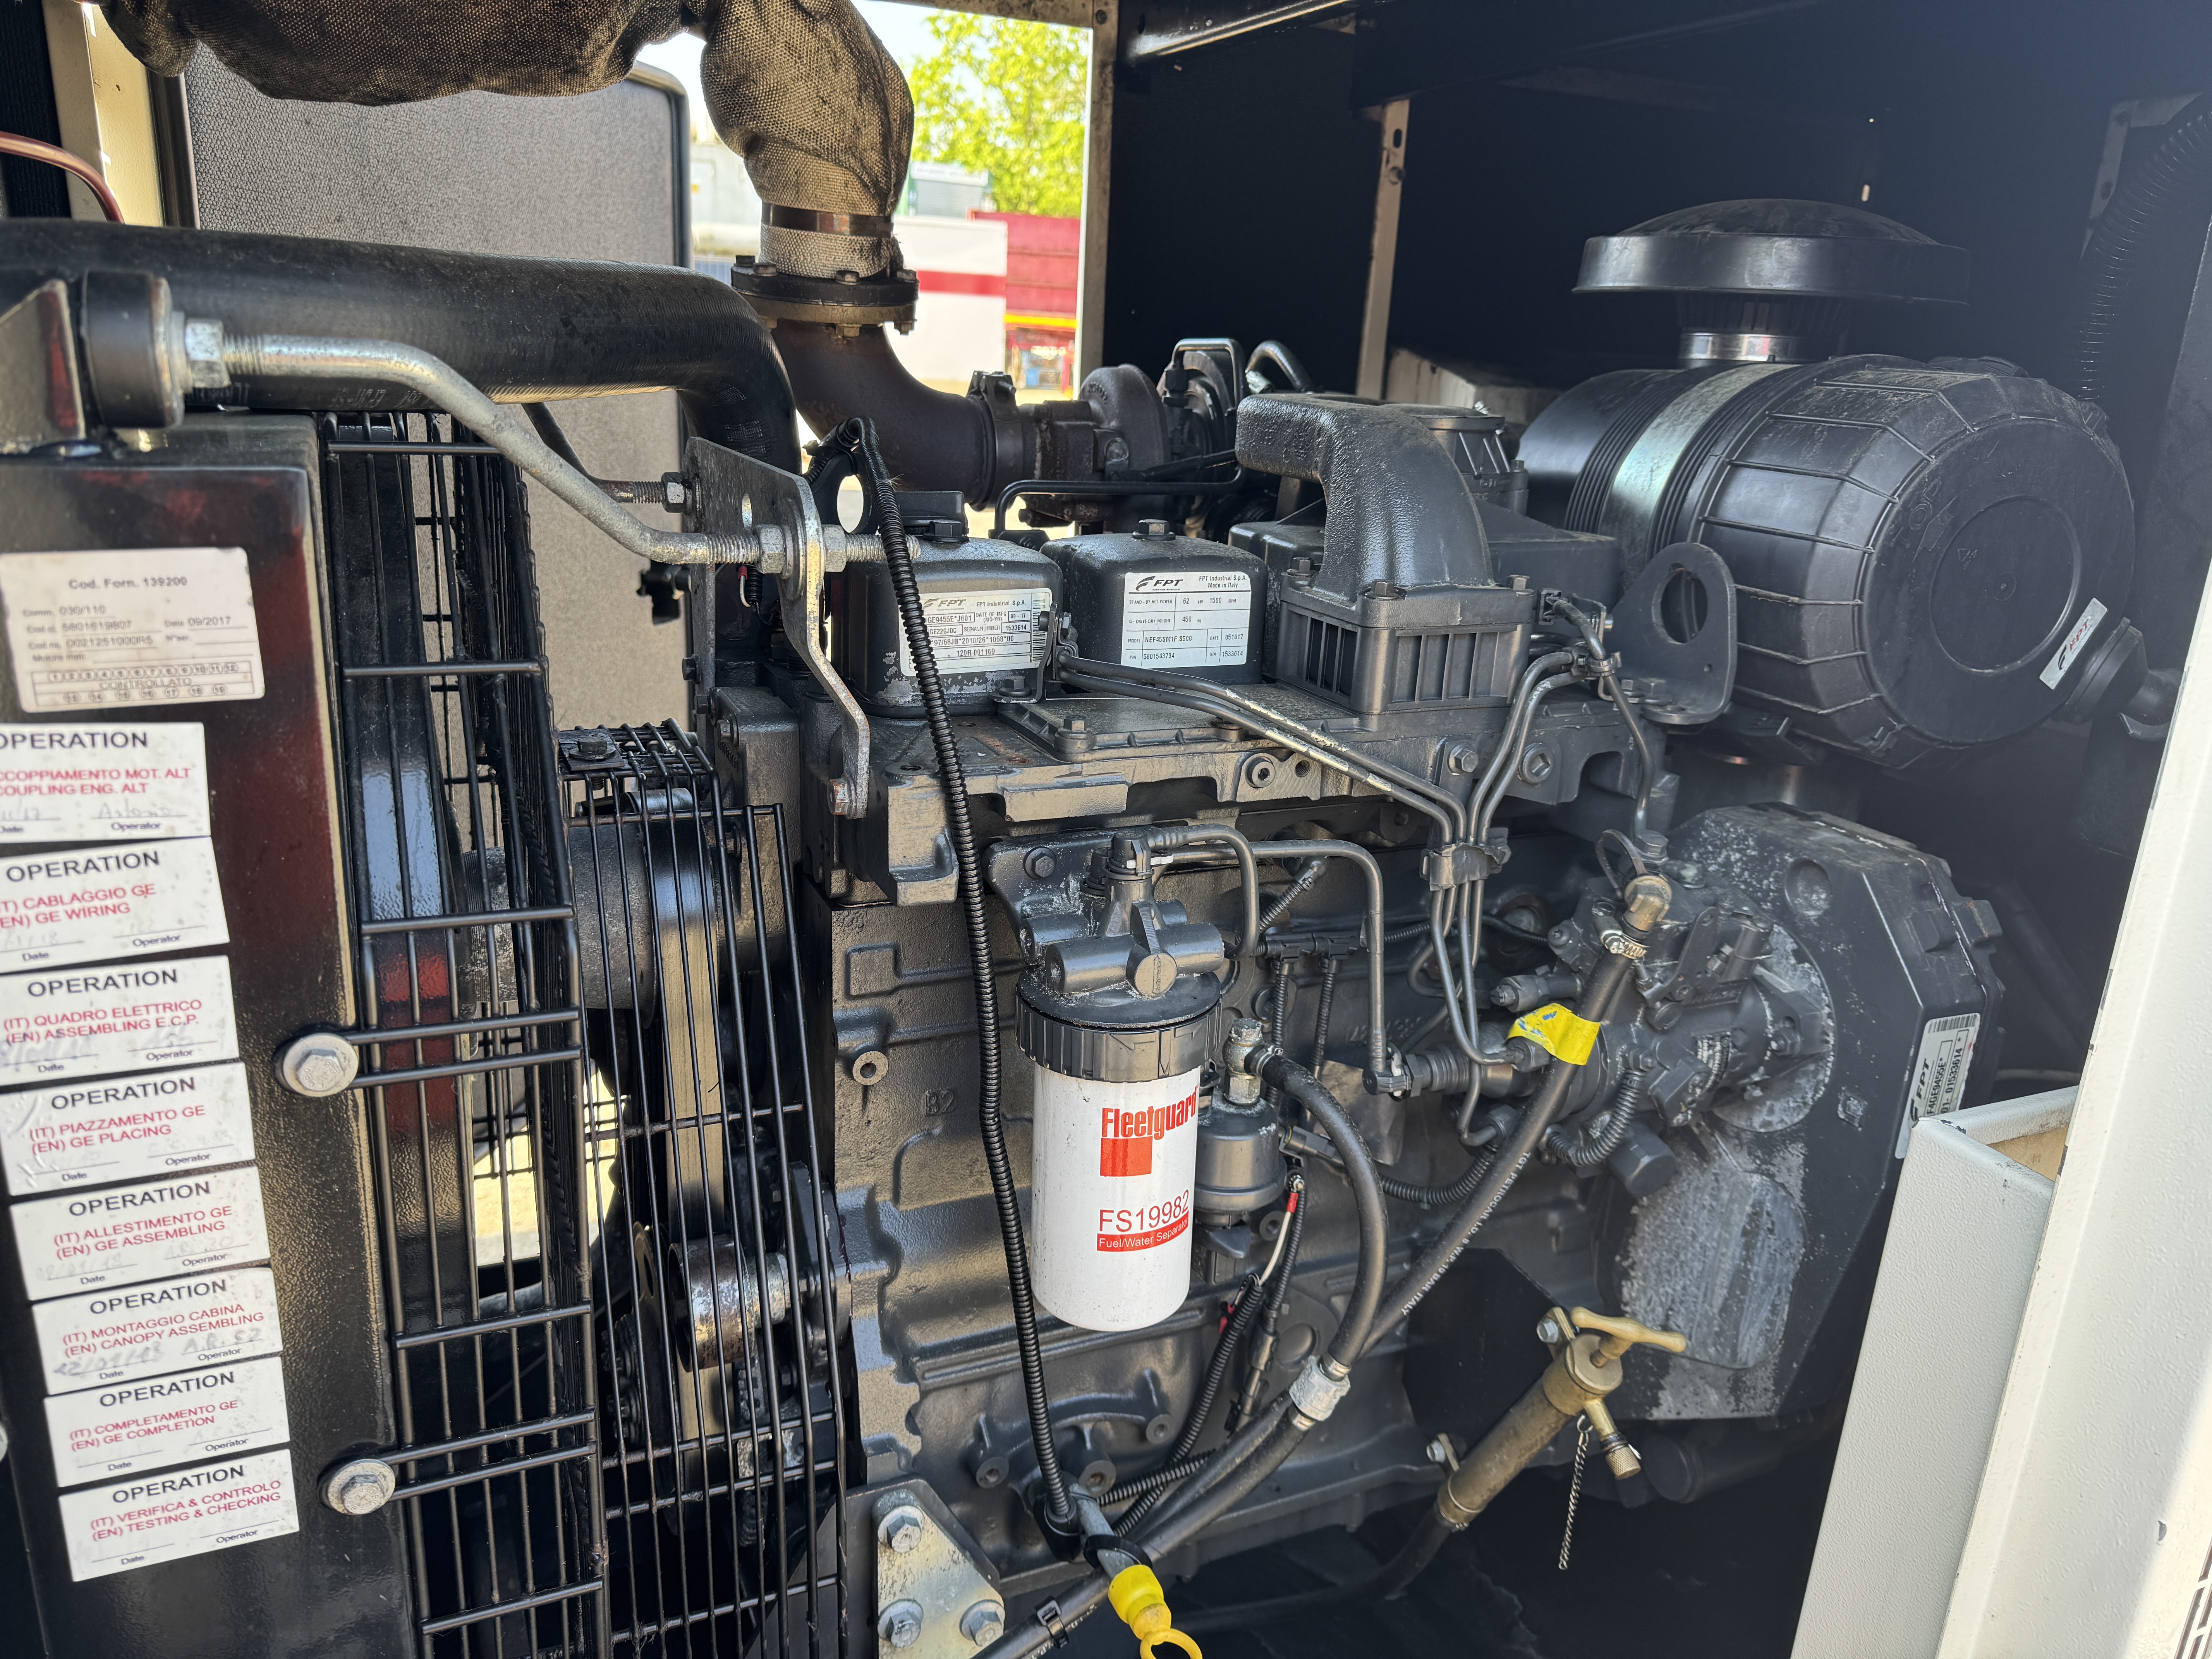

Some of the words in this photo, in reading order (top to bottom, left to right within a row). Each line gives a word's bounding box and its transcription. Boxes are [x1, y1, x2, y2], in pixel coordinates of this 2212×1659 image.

[143, 576, 187, 587] 139200
[187, 616, 231, 627] 09/2017
[957, 648, 995, 657] 120R-001169
[99, 677, 192, 690] CONTROLLATO
[0, 783, 75, 796] OUPLING
[80, 783, 115, 794] ENG.
[122, 783, 149, 793] ALT
[125, 768, 161, 779] MOT.
[165, 768, 191, 778] ALT
[111, 822, 162, 832] Operator
[7, 850, 160, 882] OPERATION
[23, 887, 127, 910] CABLAGGIO
[132, 884, 156, 896] GE
[35, 911, 60, 924] GE
[65, 903, 131, 921] WIRING
[22, 951, 50, 961] Date
[132, 934, 181, 947] Operator
[27, 969, 178, 998] OPERATION
[4, 1017, 30, 1032] (IT)
[34, 1009, 108, 1027] QUADRO
[112, 999, 203, 1018] ELETTRICO
[6, 1031, 41, 1046] (EN)
[45, 1019, 151, 1039] ASSEMBLING
[156, 1014, 199, 1028] E.C.P.
[38, 1064, 65, 1073] Date
[146, 1049, 194, 1061] Operator
[1945, 1047, 1963, 1094] 01533614
[51, 1077, 195, 1110] OPERATION
[1916, 1058, 1931, 1099] FPT
[29, 1127, 55, 1142] (IT)
[60, 1108, 178, 1136] PIAZZAMENTO
[182, 1105, 206, 1117] GE
[1101, 1085, 1197, 1140] Fleetguard
[32, 1140, 66, 1156] (EN)
[70, 1135, 95, 1149] GE
[99, 1124, 172, 1145] PLACING
[62, 1171, 87, 1182] Date
[165, 1152, 211, 1166] Operator
[69, 1181, 211, 1217] OPERATION
[1099, 1189, 1189, 1233] FS19982
[1480, 1172, 1517, 1220] PETROCAR
[53, 1232, 80, 1248] (IT)
[83, 1211, 206, 1240] ALLESTIMENTO
[210, 1205, 233, 1218] GE
[56, 1245, 91, 1261] (EN)
[94, 1239, 119, 1252] GE
[122, 1221, 225, 1247] ASSEMBLING
[1099, 1235, 1154, 1249] Fuel/Water
[1156, 1217, 1189, 1240] Separator
[80, 1274, 106, 1285] Date
[182, 1253, 227, 1267] Operator
[1422, 1273, 1441, 1292] BAR
[90, 1279, 227, 1315] OPERATION
[1401, 1292, 1424, 1316] ITALY
[62, 1331, 87, 1346] (IT)
[91, 1314, 186, 1339] MONTAGGIO
[189, 1303, 245, 1321] CABINA
[64, 1343, 98, 1358] (EN)
[101, 1329, 165, 1350] CANOPY
[168, 1312, 264, 1338] ASSEMBLING
[99, 1369, 124, 1380] Date
[198, 1346, 242, 1362] Operator
[99, 1371, 235, 1408] OPERATION
[69, 1427, 92, 1441] (IT)
[94, 1404, 216, 1434] COMPLETAMENTO
[219, 1399, 239, 1411] GE
[71, 1438, 100, 1453] (EN)
[103, 1433, 124, 1444] GE
[126, 1415, 215, 1440] COMPLETION
[107, 1460, 132, 1472] Date
[205, 1437, 249, 1452] Operator
[112, 1465, 245, 1503] OPERATION
[90, 1516, 114, 1530] (IT)
[117, 1501, 186, 1523] VERIFICA
[188, 1498, 198, 1508] &
[201, 1480, 282, 1504] CONTROLO
[92, 1527, 123, 1542] (EN)
[127, 1512, 190, 1533] TESTING
[194, 1509, 203, 1518] &
[206, 1491, 282, 1516] CHECKING
[120, 1554, 145, 1565] Date
[216, 1529, 259, 1544] Operator
